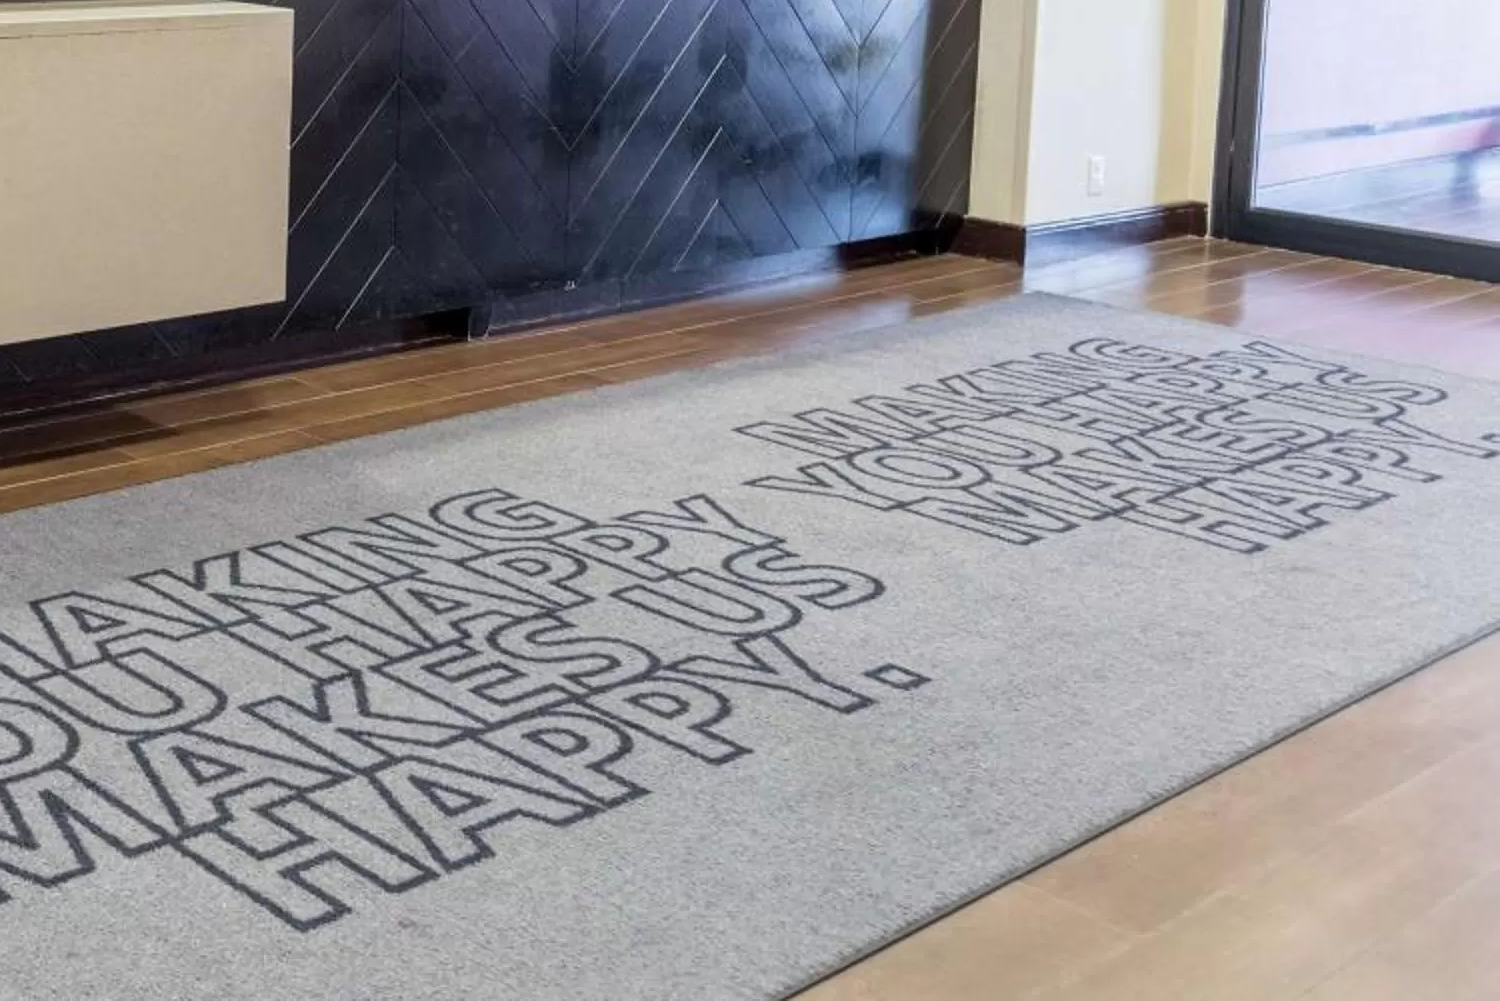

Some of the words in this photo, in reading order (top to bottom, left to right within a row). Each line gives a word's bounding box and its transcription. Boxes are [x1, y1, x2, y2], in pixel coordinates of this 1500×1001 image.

[732, 337, 1203, 460] MAKING
[742, 424, 1063, 511] YOU
[1008, 340, 1350, 445] HAPPY
[900, 400, 1334, 546] MAKES
[1256, 369, 1449, 424] US
[218, 494, 787, 681] HAPPY
[608, 544, 886, 636] US
[170, 633, 930, 931] HAPPY.
